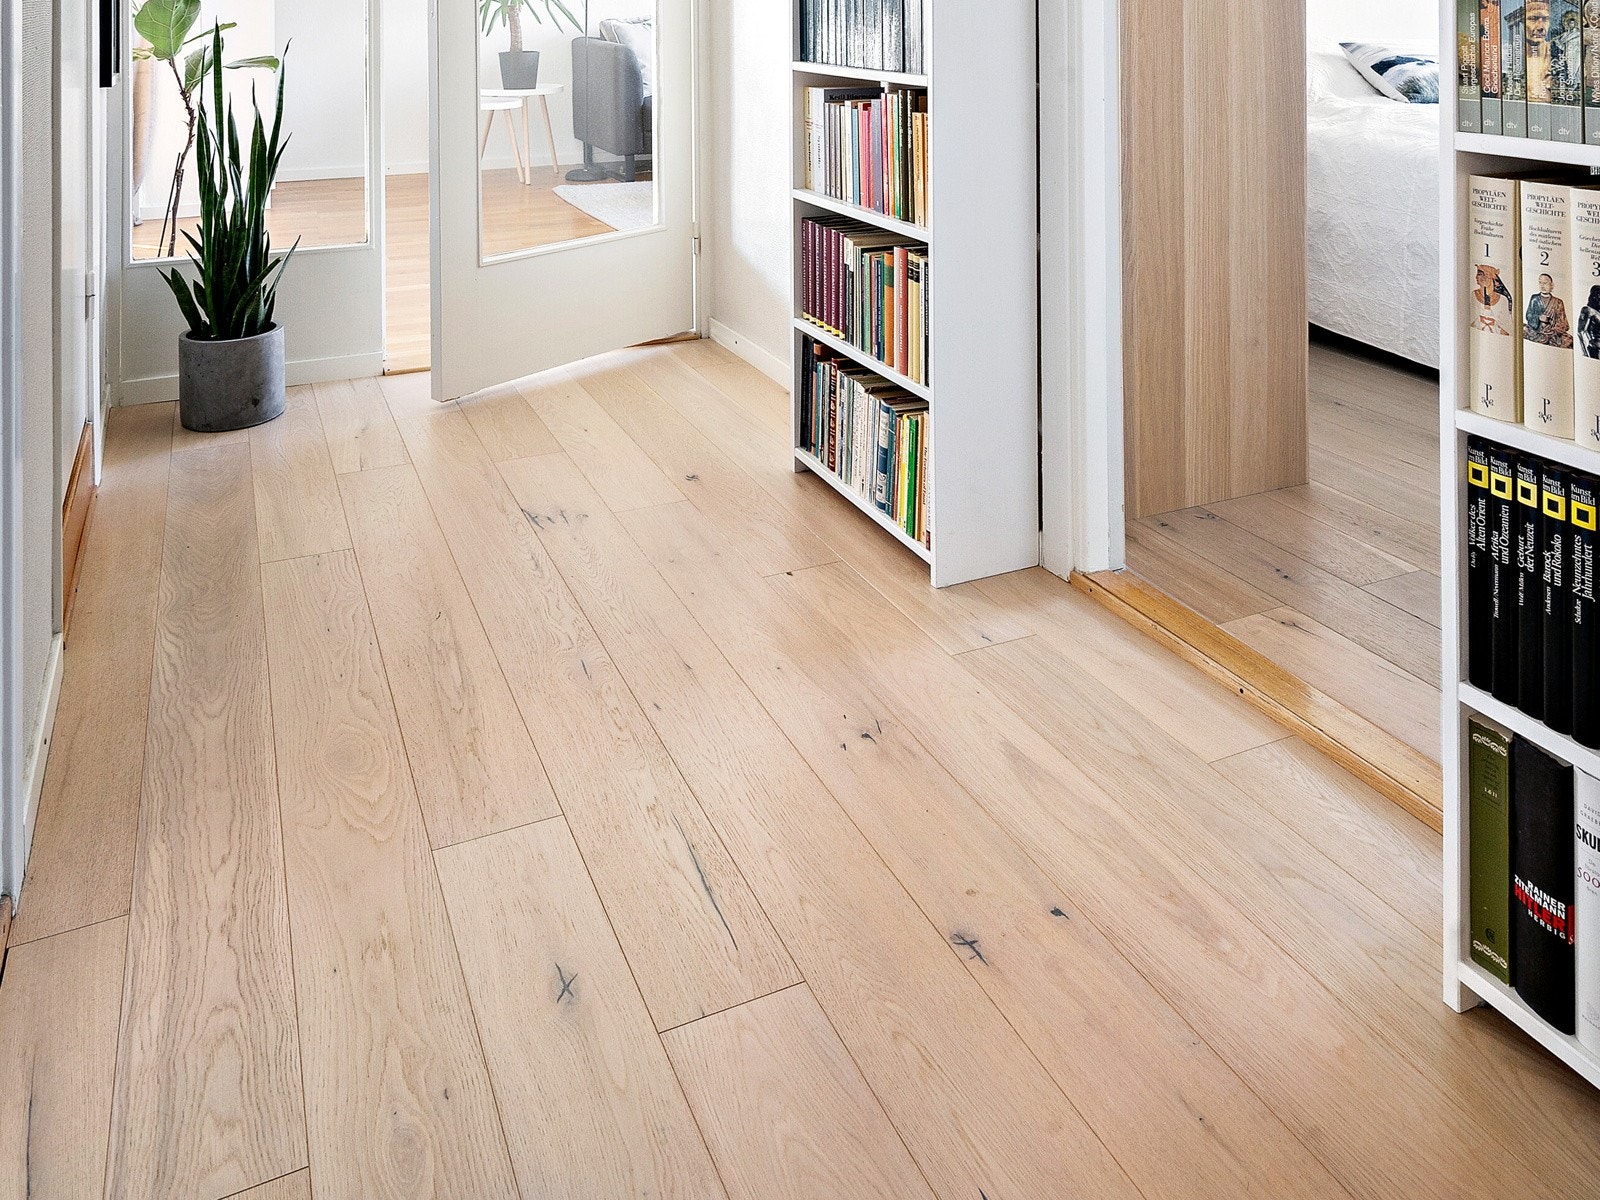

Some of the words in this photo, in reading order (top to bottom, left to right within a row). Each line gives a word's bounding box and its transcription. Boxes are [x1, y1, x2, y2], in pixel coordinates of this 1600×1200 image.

[1472, 201, 1507, 211] GESCHICHTE
[1526, 207, 1566, 218] GESCHICHTE
[1484, 244, 1490, 258] 1
[1540, 251, 1549, 266] 2
[1474, 456, 1488, 465] Bild
[1490, 456, 1508, 468] Kunst
[1498, 468, 1511, 476] Bild
[1523, 474, 1536, 484] Bild
[1543, 474, 1561, 488] Kunst
[1551, 487, 1565, 496] Bild
[1571, 483, 1591, 497] Kunst
[1571, 493, 1580, 501] im
[1581, 496, 1596, 506] Bild
[1476, 498, 1485, 525] Orient
[1499, 505, 1509, 546] Ozeanien
[1476, 525, 1485, 551] Alten
[1491, 531, 1499, 560] Afrika
[1525, 522, 1534, 557] Neuzeit
[1551, 534, 1561, 568] Rokoko
[1525, 557, 1534, 572] der
[1543, 550, 1551, 583] Barock
[1572, 534, 1582, 595] Neunzehntes
[1582, 543, 1596, 602] Jahrhundert
[1514, 874, 1565, 919] ZITELMANN
[1527, 880, 1566, 910] RAINER
[1514, 883, 1565, 932] HITLER
[1527, 909, 1566, 940] HERBIG
